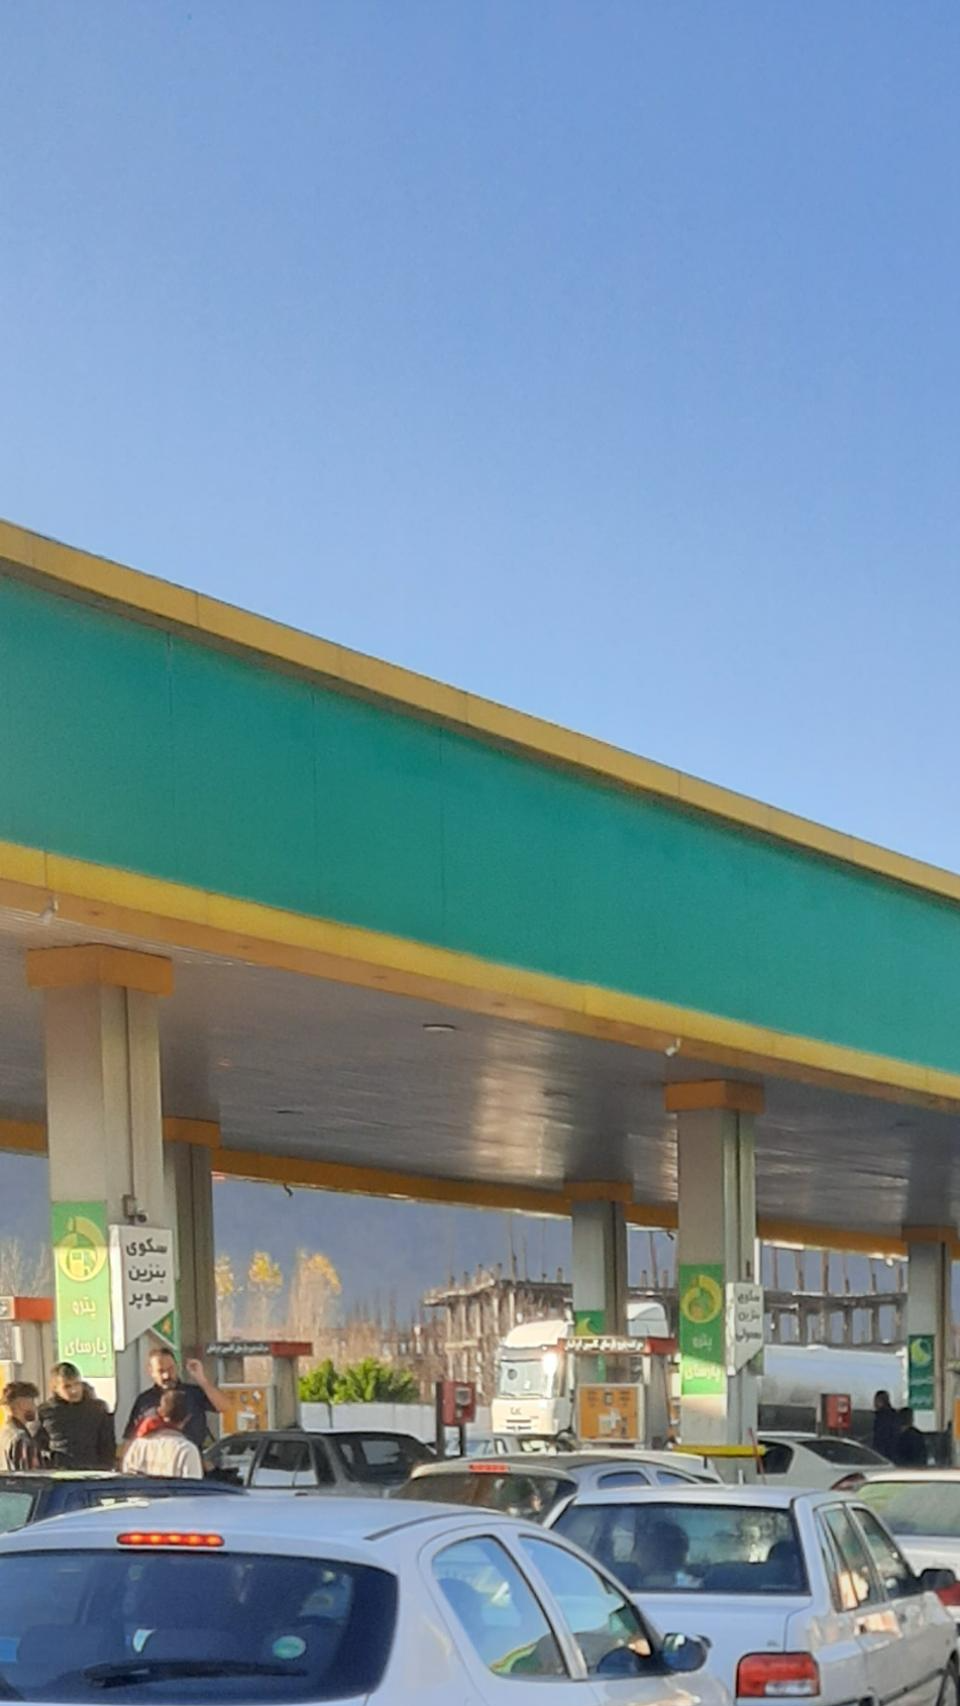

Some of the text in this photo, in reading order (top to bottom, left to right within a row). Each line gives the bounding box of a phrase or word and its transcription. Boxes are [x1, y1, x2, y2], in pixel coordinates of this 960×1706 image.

[126, 1238, 168, 1257] سکوی
[128, 1264, 166, 1283] بنزین
[129, 1292, 168, 1309] سوپر
